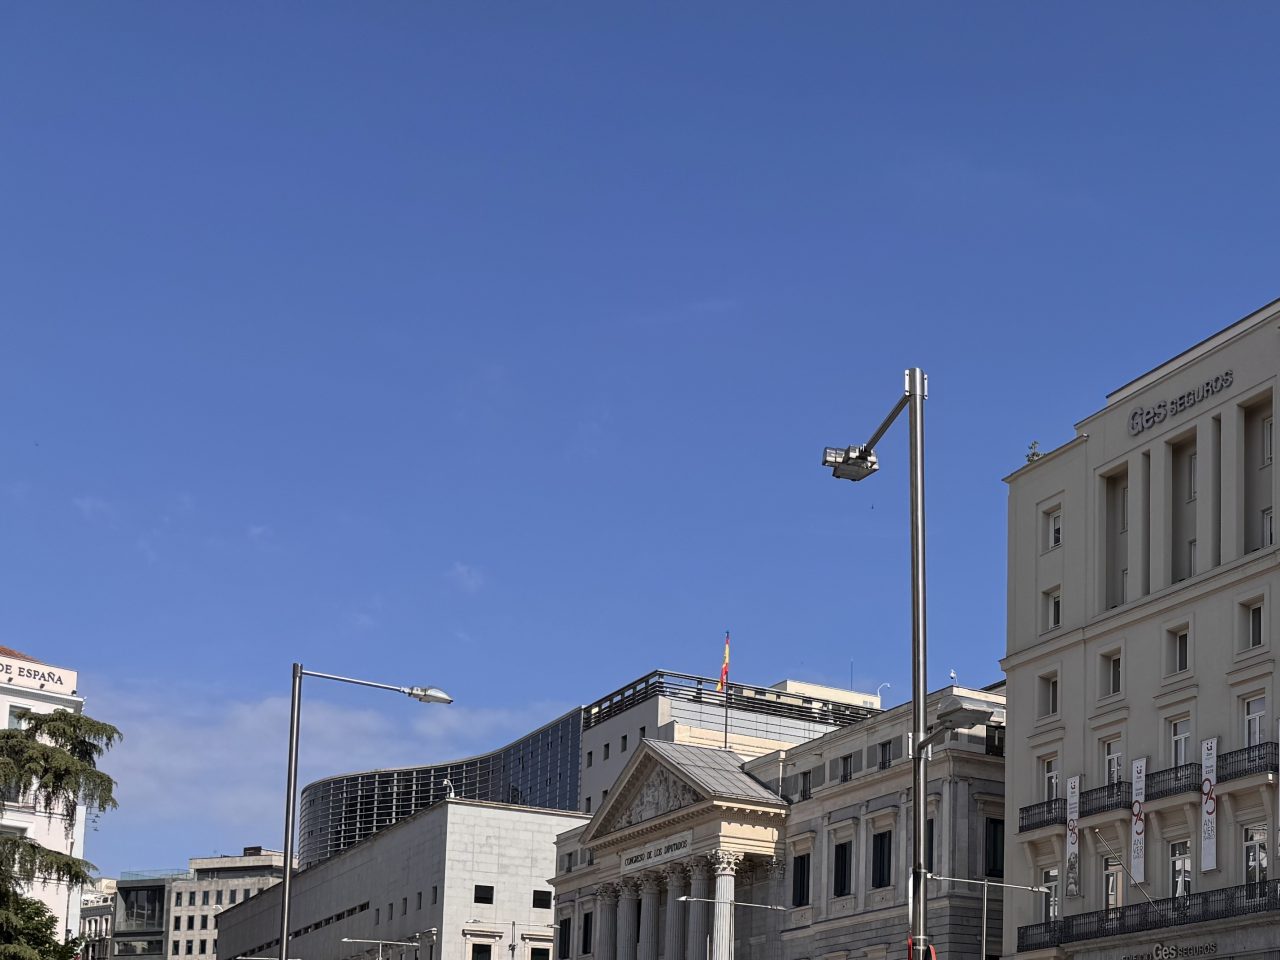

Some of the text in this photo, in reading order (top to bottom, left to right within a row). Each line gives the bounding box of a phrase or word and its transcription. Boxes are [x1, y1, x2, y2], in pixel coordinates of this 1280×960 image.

[1128, 370, 1233, 437] Ges SEGUROS
[18, 666, 64, 685] ESPAÑA
[1202, 778, 1216, 815] 95
[1132, 800, 1144, 835] 95
[1153, 943, 1177, 960] Ges
[1177, 943, 1217, 957] SEGUROS
